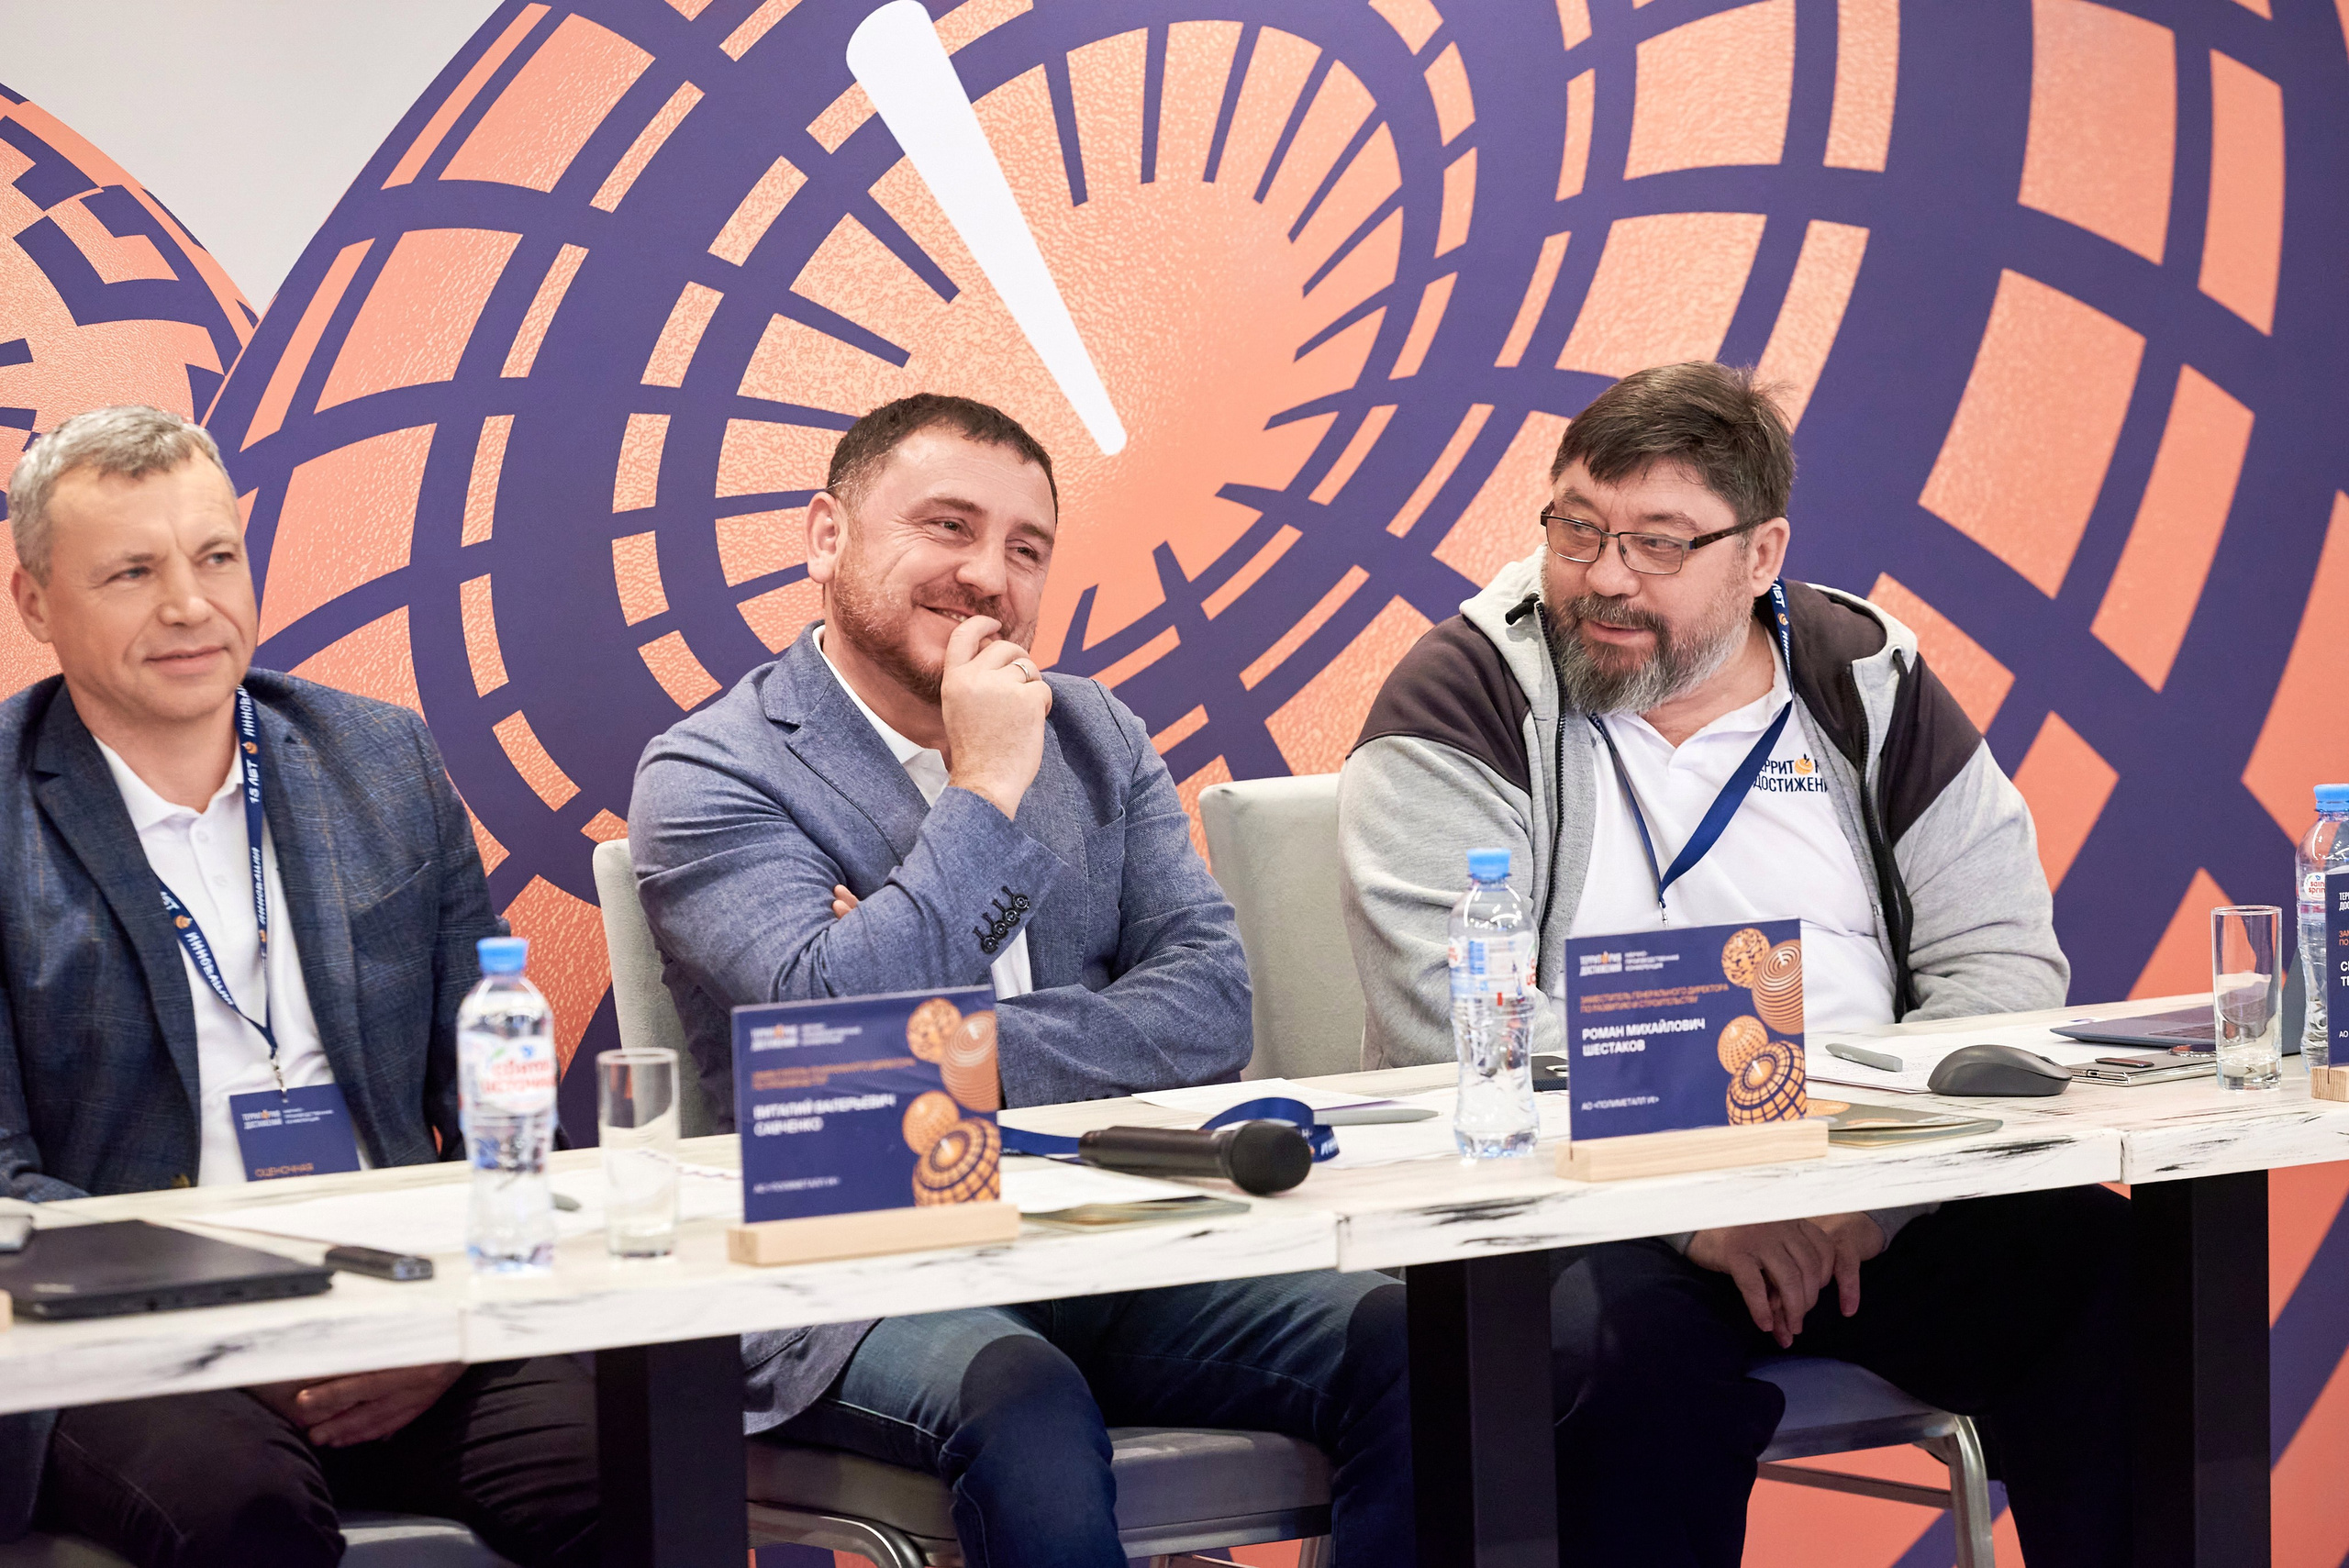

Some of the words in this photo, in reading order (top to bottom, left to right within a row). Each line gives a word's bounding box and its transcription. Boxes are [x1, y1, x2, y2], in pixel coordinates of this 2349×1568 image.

[237, 684, 256, 738] ИННОВА
[246, 759, 260, 786] ЛЕТ
[249, 787, 260, 804] 15
[1582, 1025, 1624, 1040] РОМАН
[1626, 1018, 1706, 1036] МИХАЙЛОВИЧ
[1582, 1040, 1645, 1056] ШЕСТАКОВ
[1581, 1102, 1593, 1111] АО
